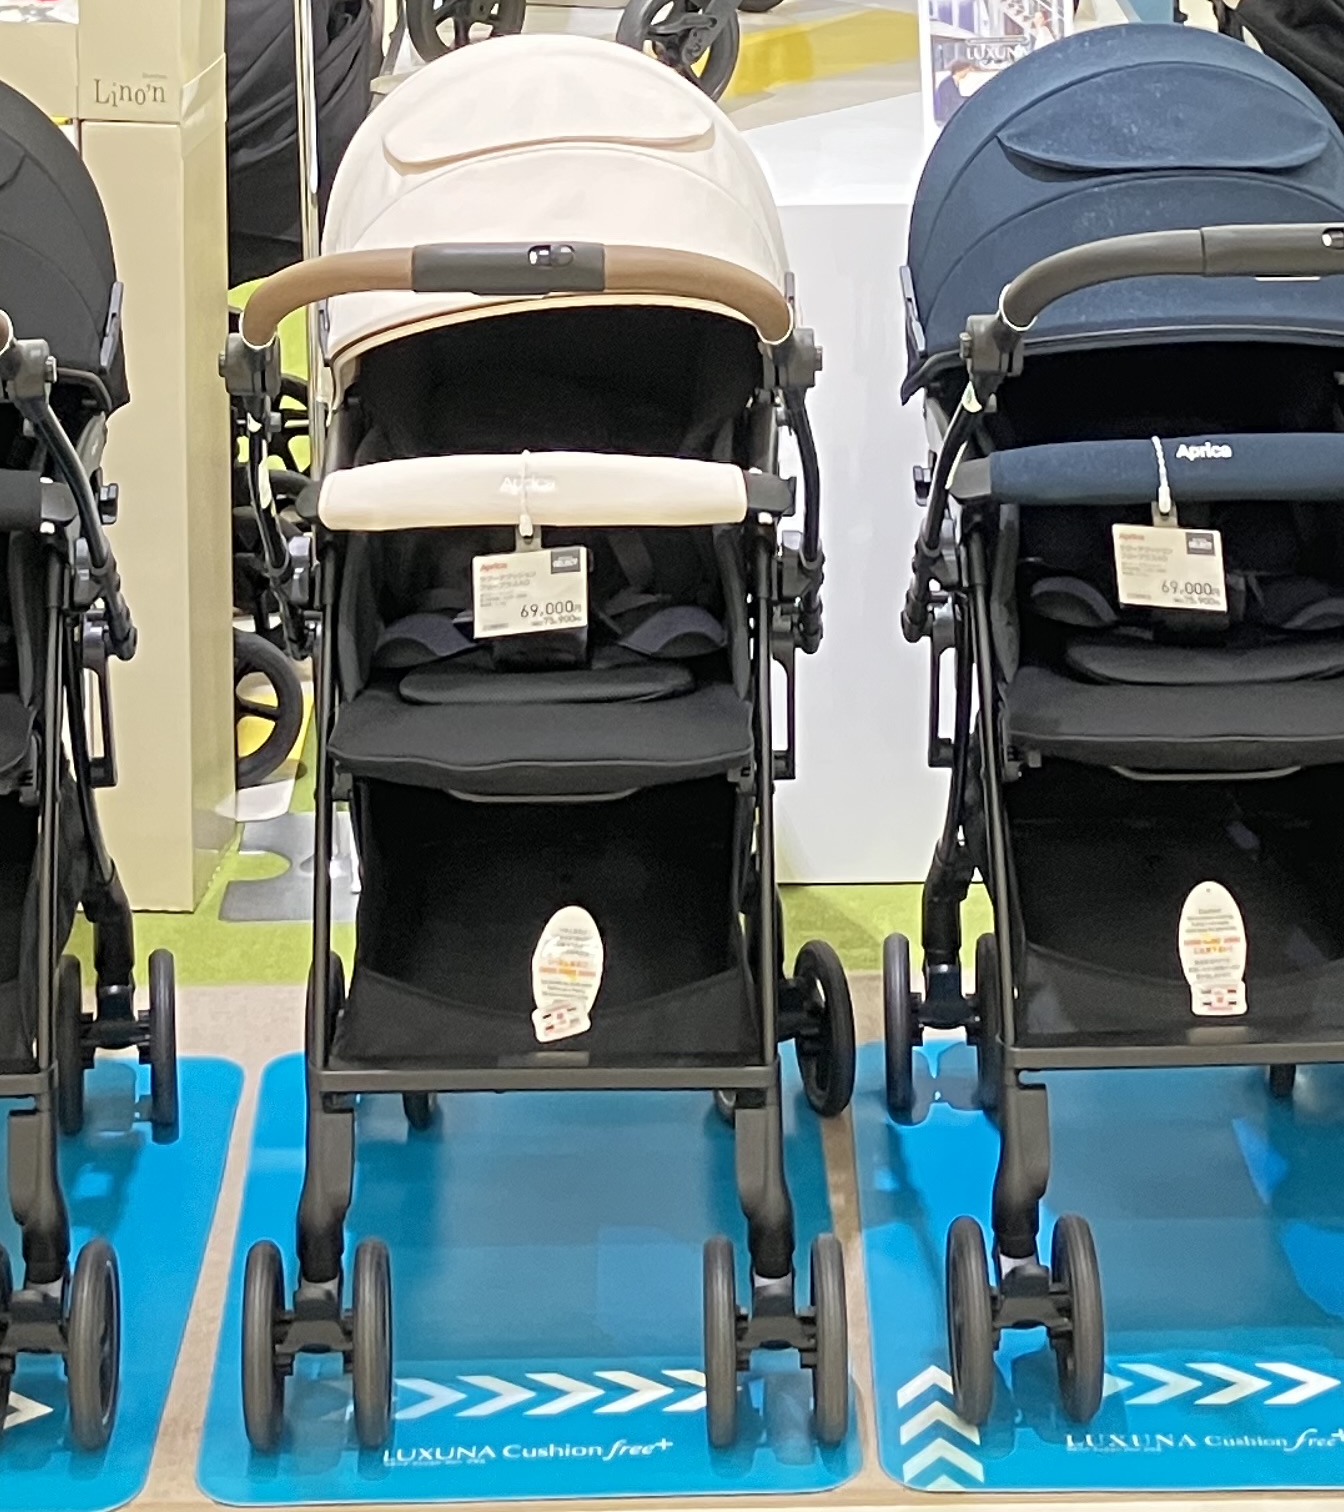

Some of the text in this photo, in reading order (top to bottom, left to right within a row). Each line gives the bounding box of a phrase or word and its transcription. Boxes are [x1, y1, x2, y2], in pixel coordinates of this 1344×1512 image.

[1176, 441, 1233, 461] Aprica
[1065, 1432, 1197, 1448] LUXUNA
[1204, 1432, 1288, 1448] Cushion
[382, 1443, 496, 1462] LUXUNA
[501, 1440, 604, 1460] Cushion
